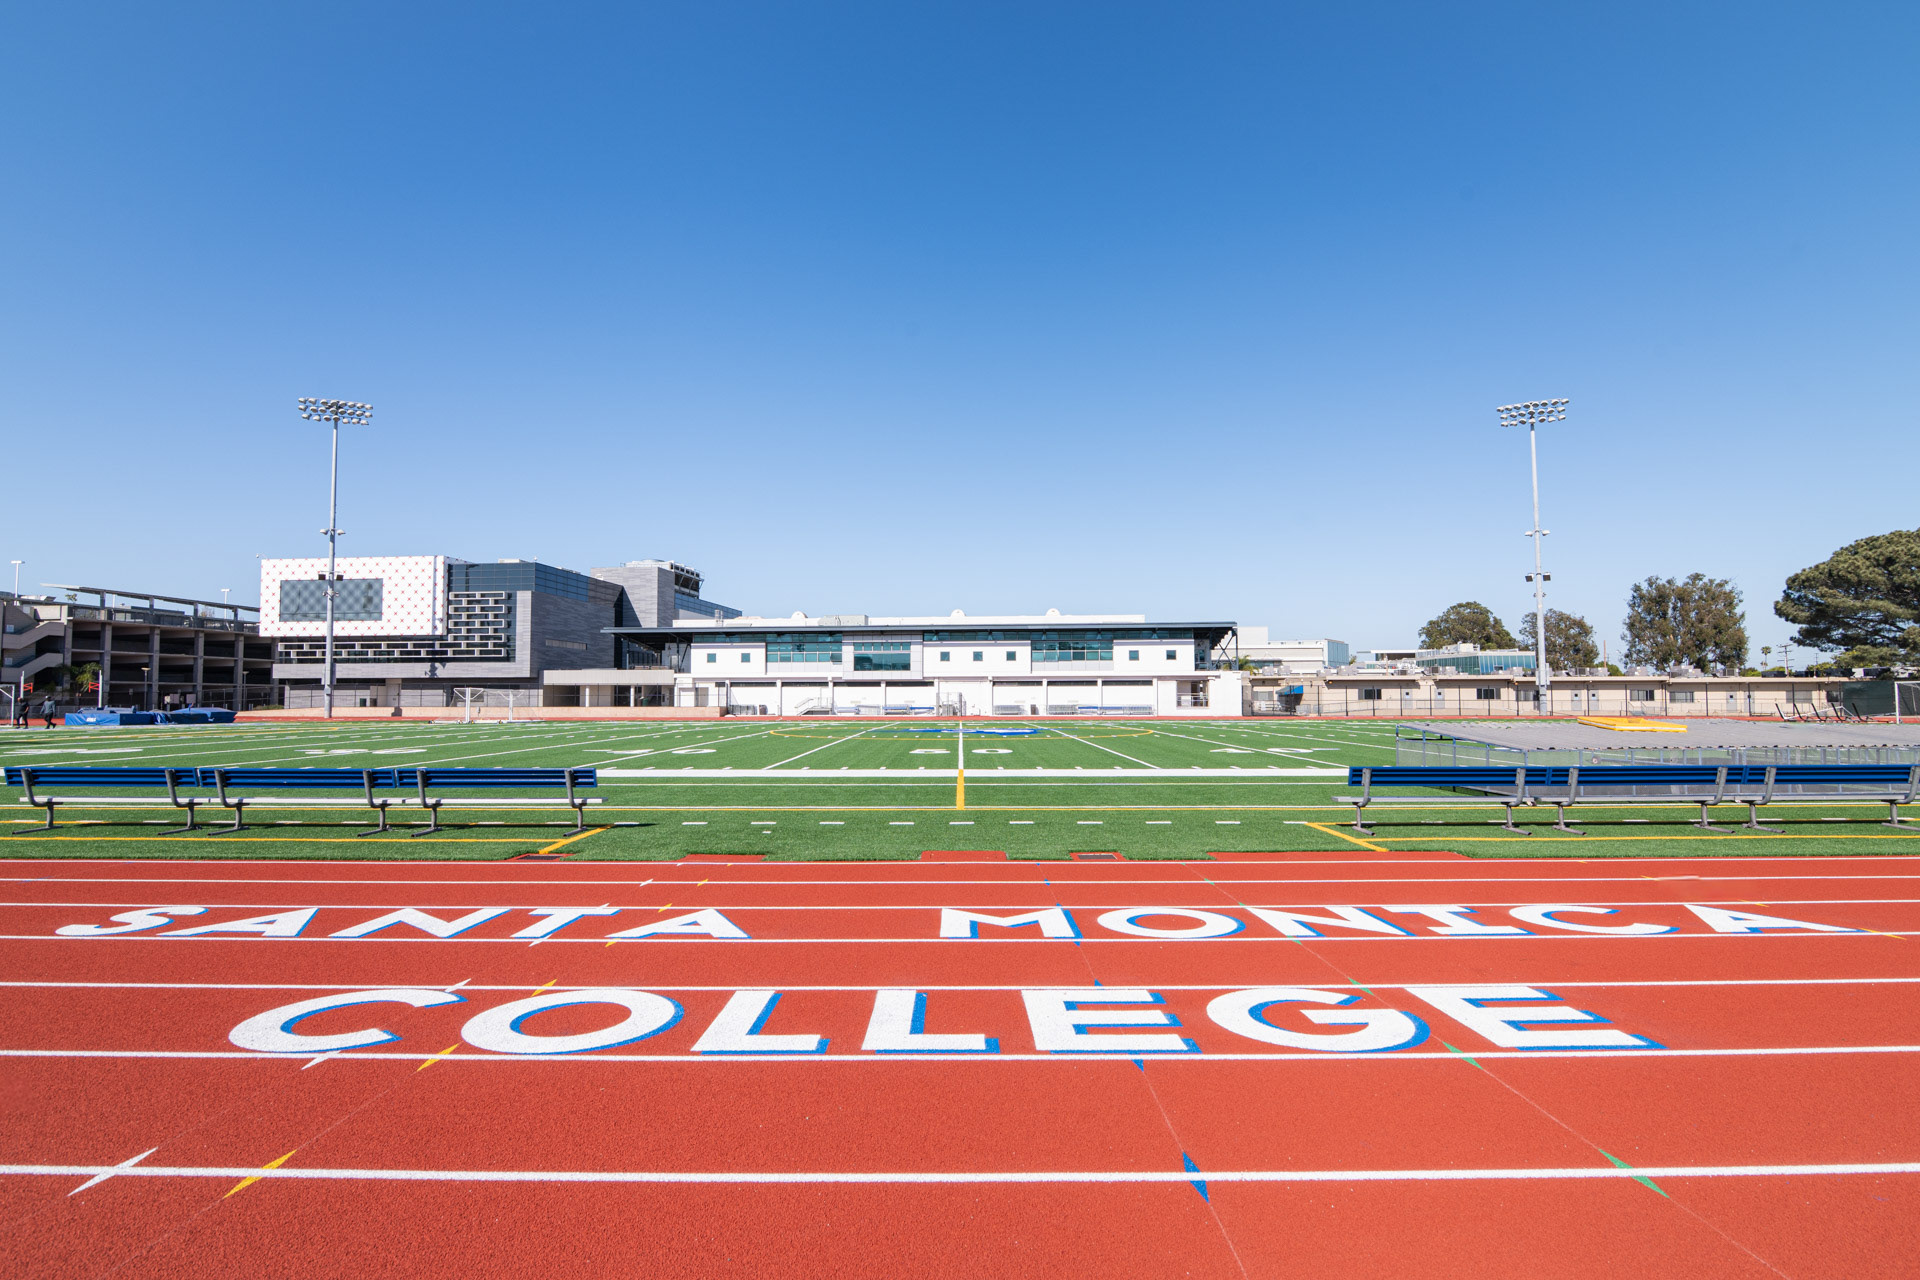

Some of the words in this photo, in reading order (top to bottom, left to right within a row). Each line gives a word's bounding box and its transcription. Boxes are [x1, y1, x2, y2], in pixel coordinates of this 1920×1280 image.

[55, 906, 752, 940] SANTA
[939, 903, 1870, 940] MONICA
[228, 987, 1669, 1055] COLLEGE
